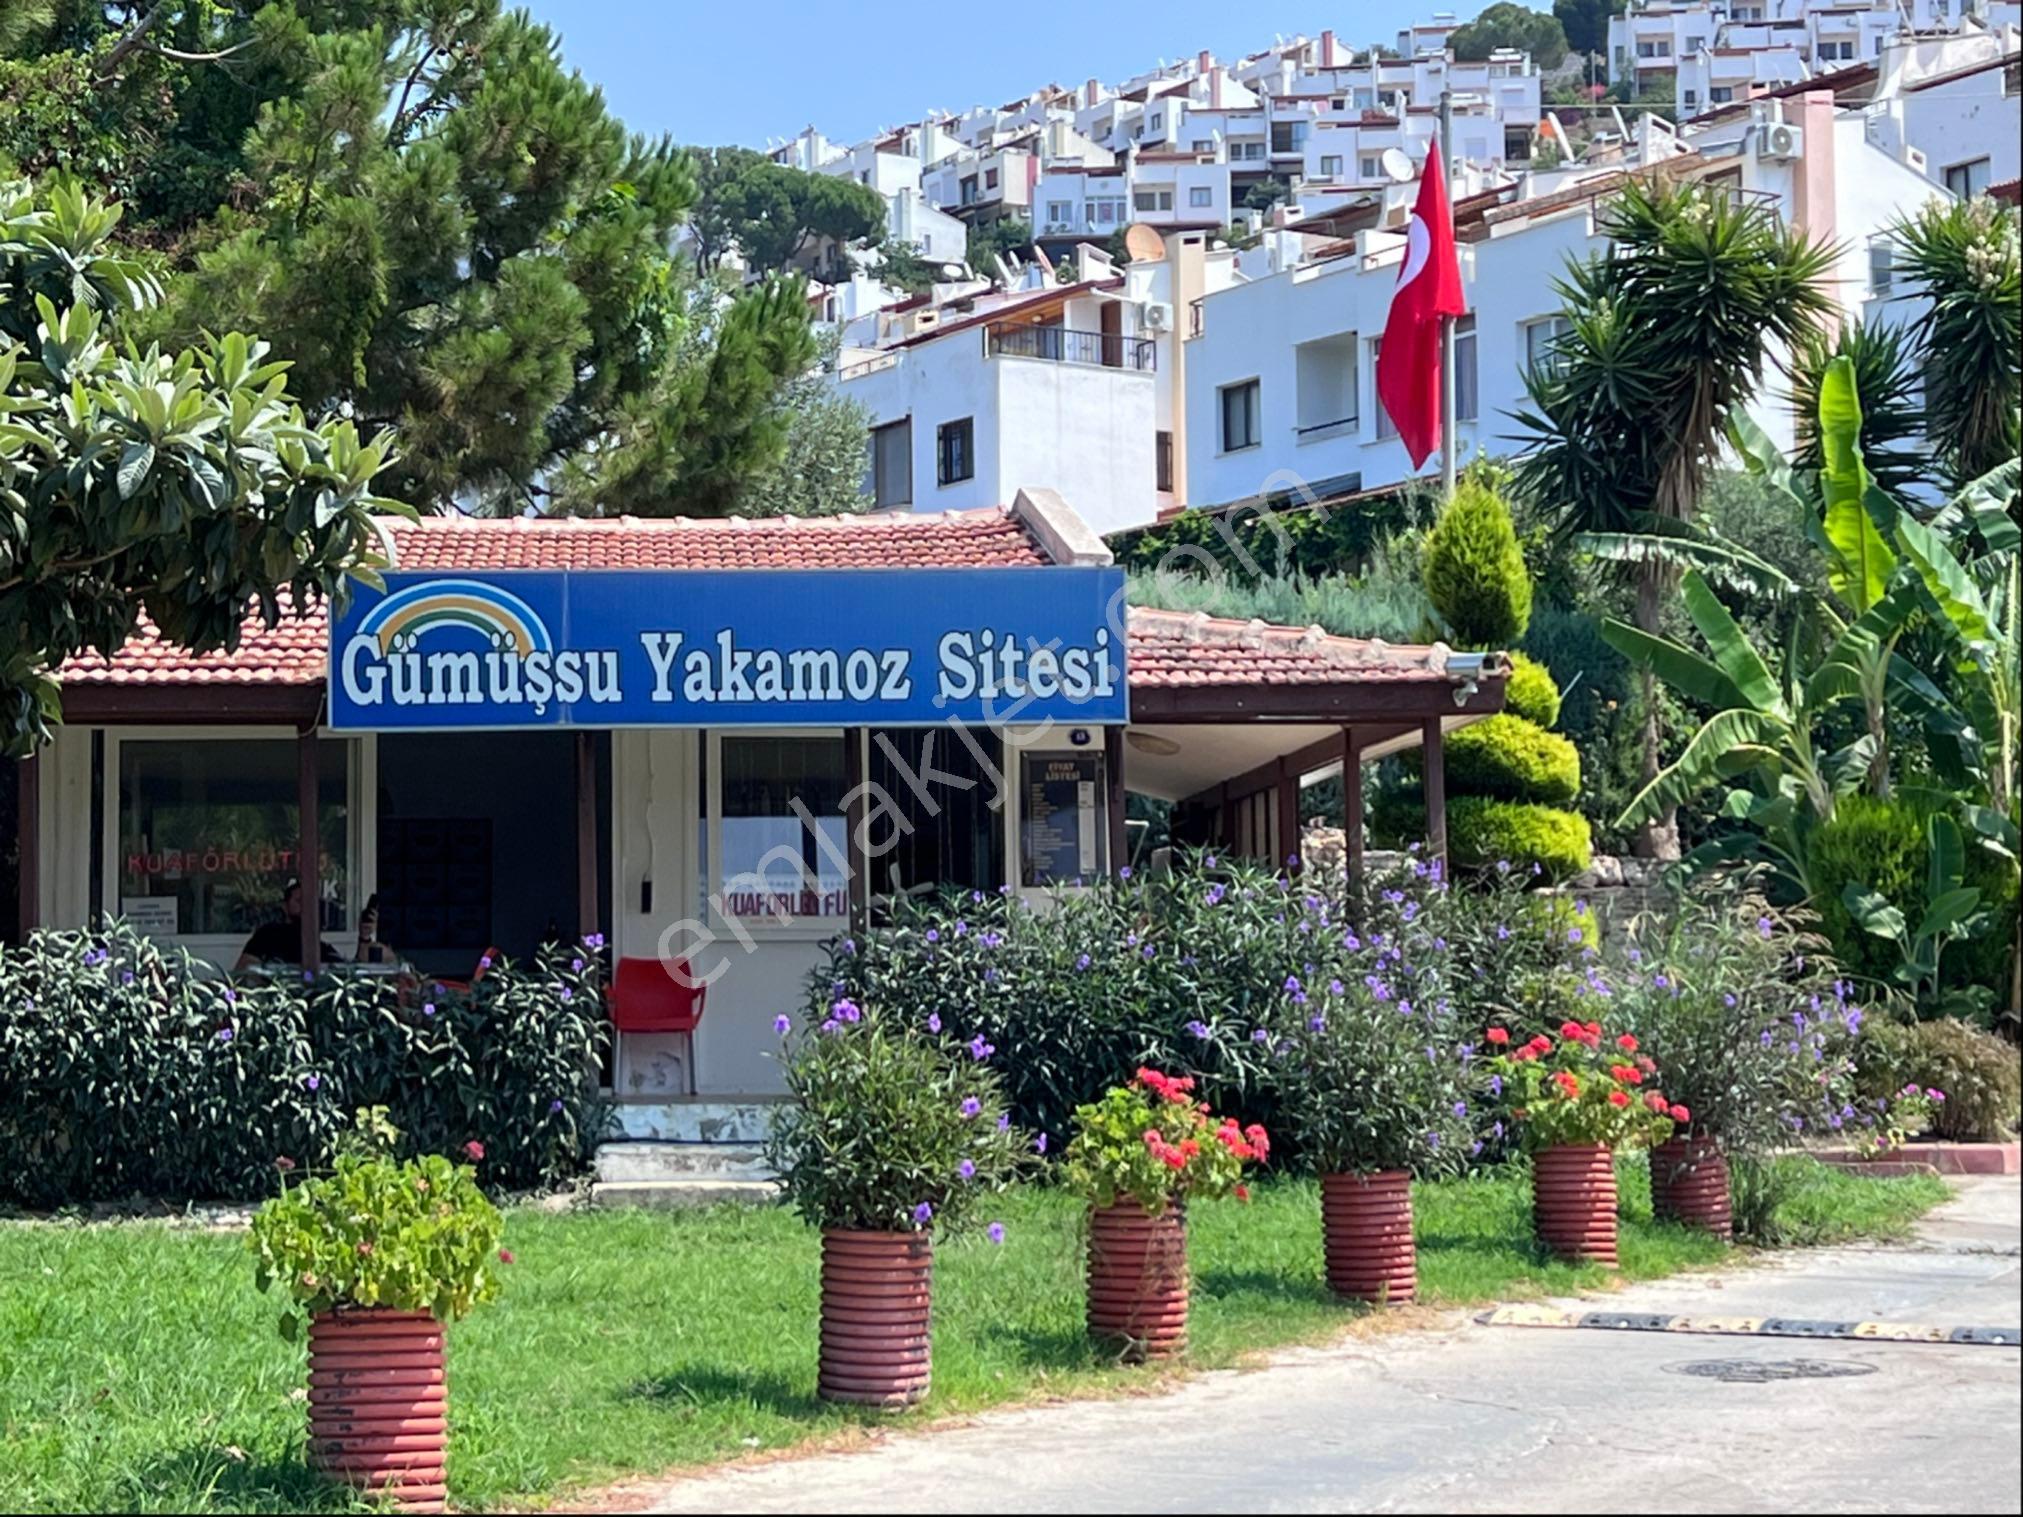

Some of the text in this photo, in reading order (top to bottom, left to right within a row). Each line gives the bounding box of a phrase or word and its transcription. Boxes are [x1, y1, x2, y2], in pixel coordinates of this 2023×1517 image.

[341, 628, 1114, 716] Gümüşsu Yakamoz Sitesi
